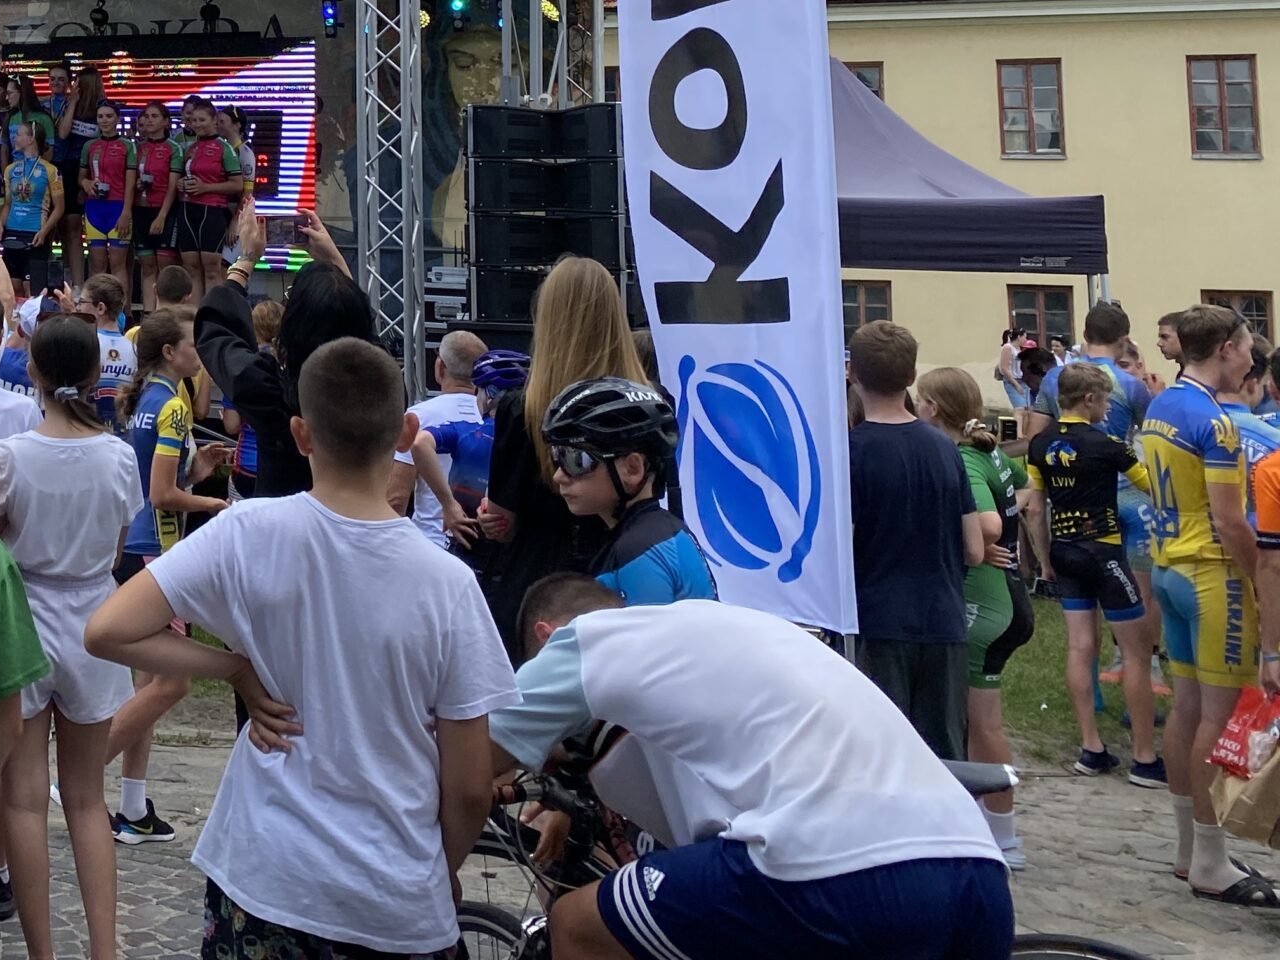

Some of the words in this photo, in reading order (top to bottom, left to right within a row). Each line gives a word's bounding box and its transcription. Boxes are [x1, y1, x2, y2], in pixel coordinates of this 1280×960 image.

[1052, 476, 1076, 487] LVIV
[1106, 507, 1118, 532] LVIV
[1225, 579, 1243, 666] UKRAINE
